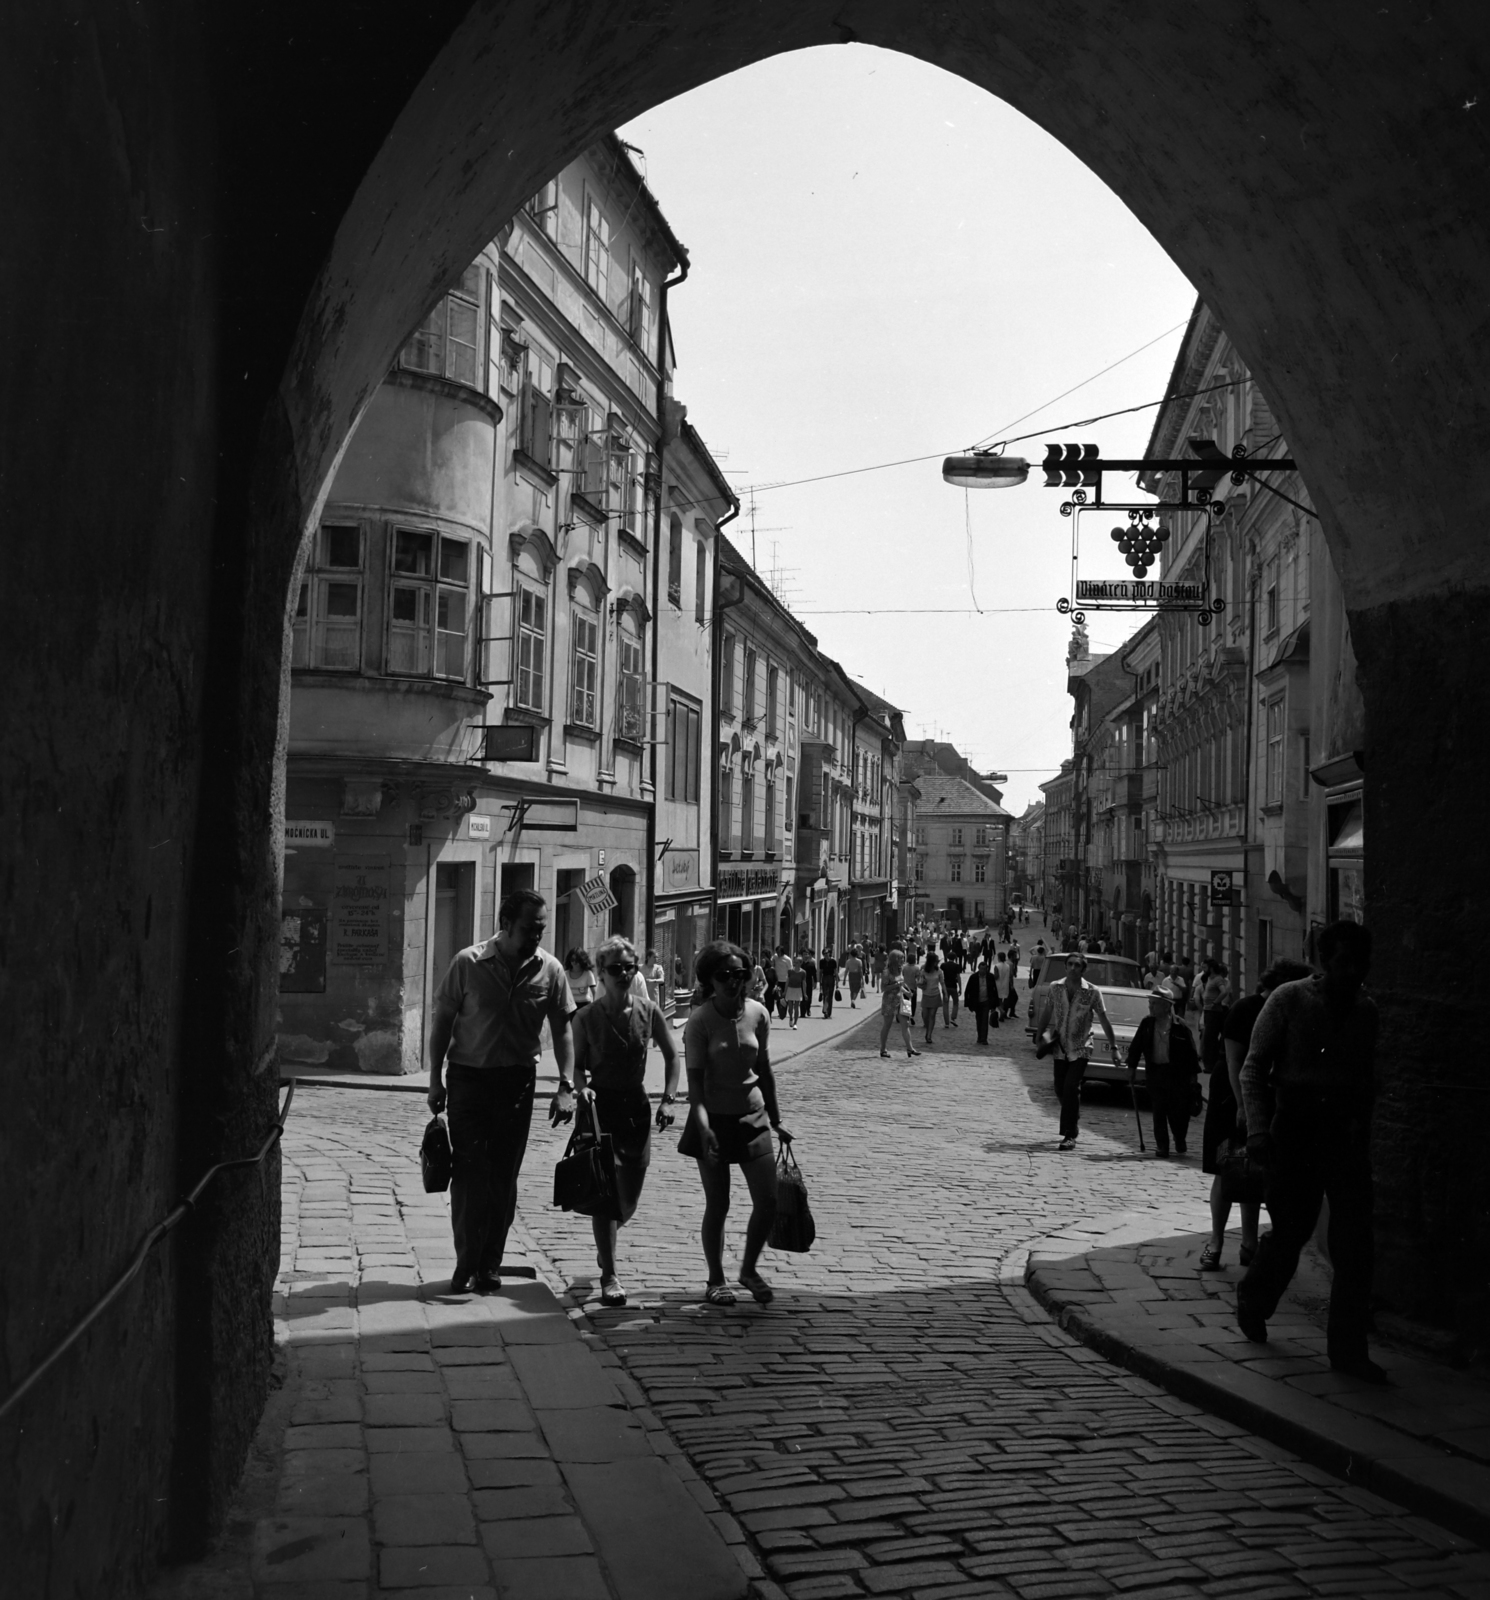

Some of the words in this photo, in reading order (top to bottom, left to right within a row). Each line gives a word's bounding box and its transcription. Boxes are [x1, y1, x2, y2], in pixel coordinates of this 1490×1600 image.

[1080, 580, 1128, 598] Vináreň
[1132, 581, 1154, 602] pod
[1158, 581, 1201, 599] baštou
